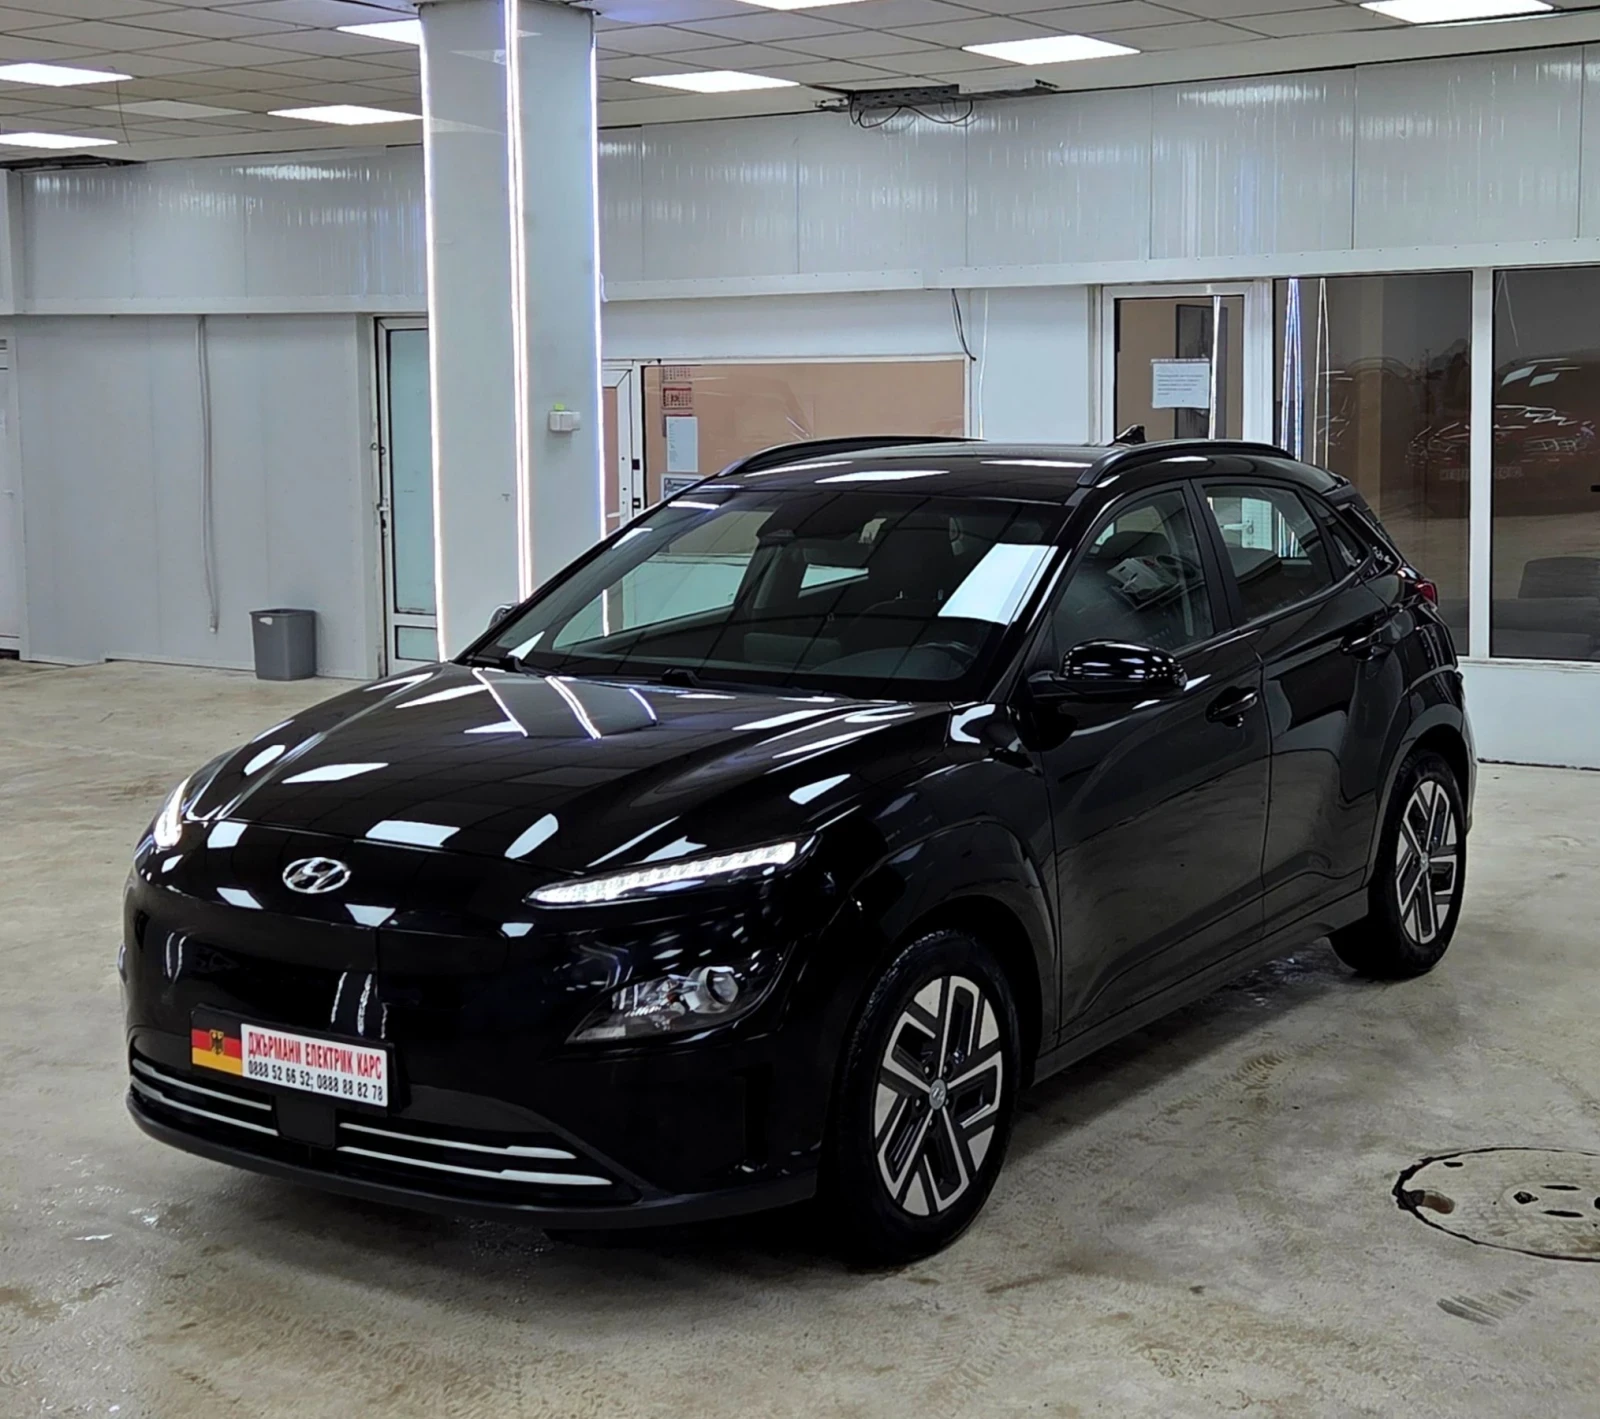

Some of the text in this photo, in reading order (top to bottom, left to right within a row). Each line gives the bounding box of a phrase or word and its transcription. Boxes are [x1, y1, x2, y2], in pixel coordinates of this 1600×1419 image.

[248, 1031, 382, 1080] ДЖЪРМАНИ ЕЛЕКТРИК КАРС
[248, 1059, 269, 1078] 0888
[272, 1064, 283, 1081] 52
[286, 1067, 296, 1084] 66
[316, 1073, 339, 1093] 0888
[342, 1078, 354, 1096] 88
[357, 1081, 368, 1099] 82
[371, 1084, 383, 1102] 78
